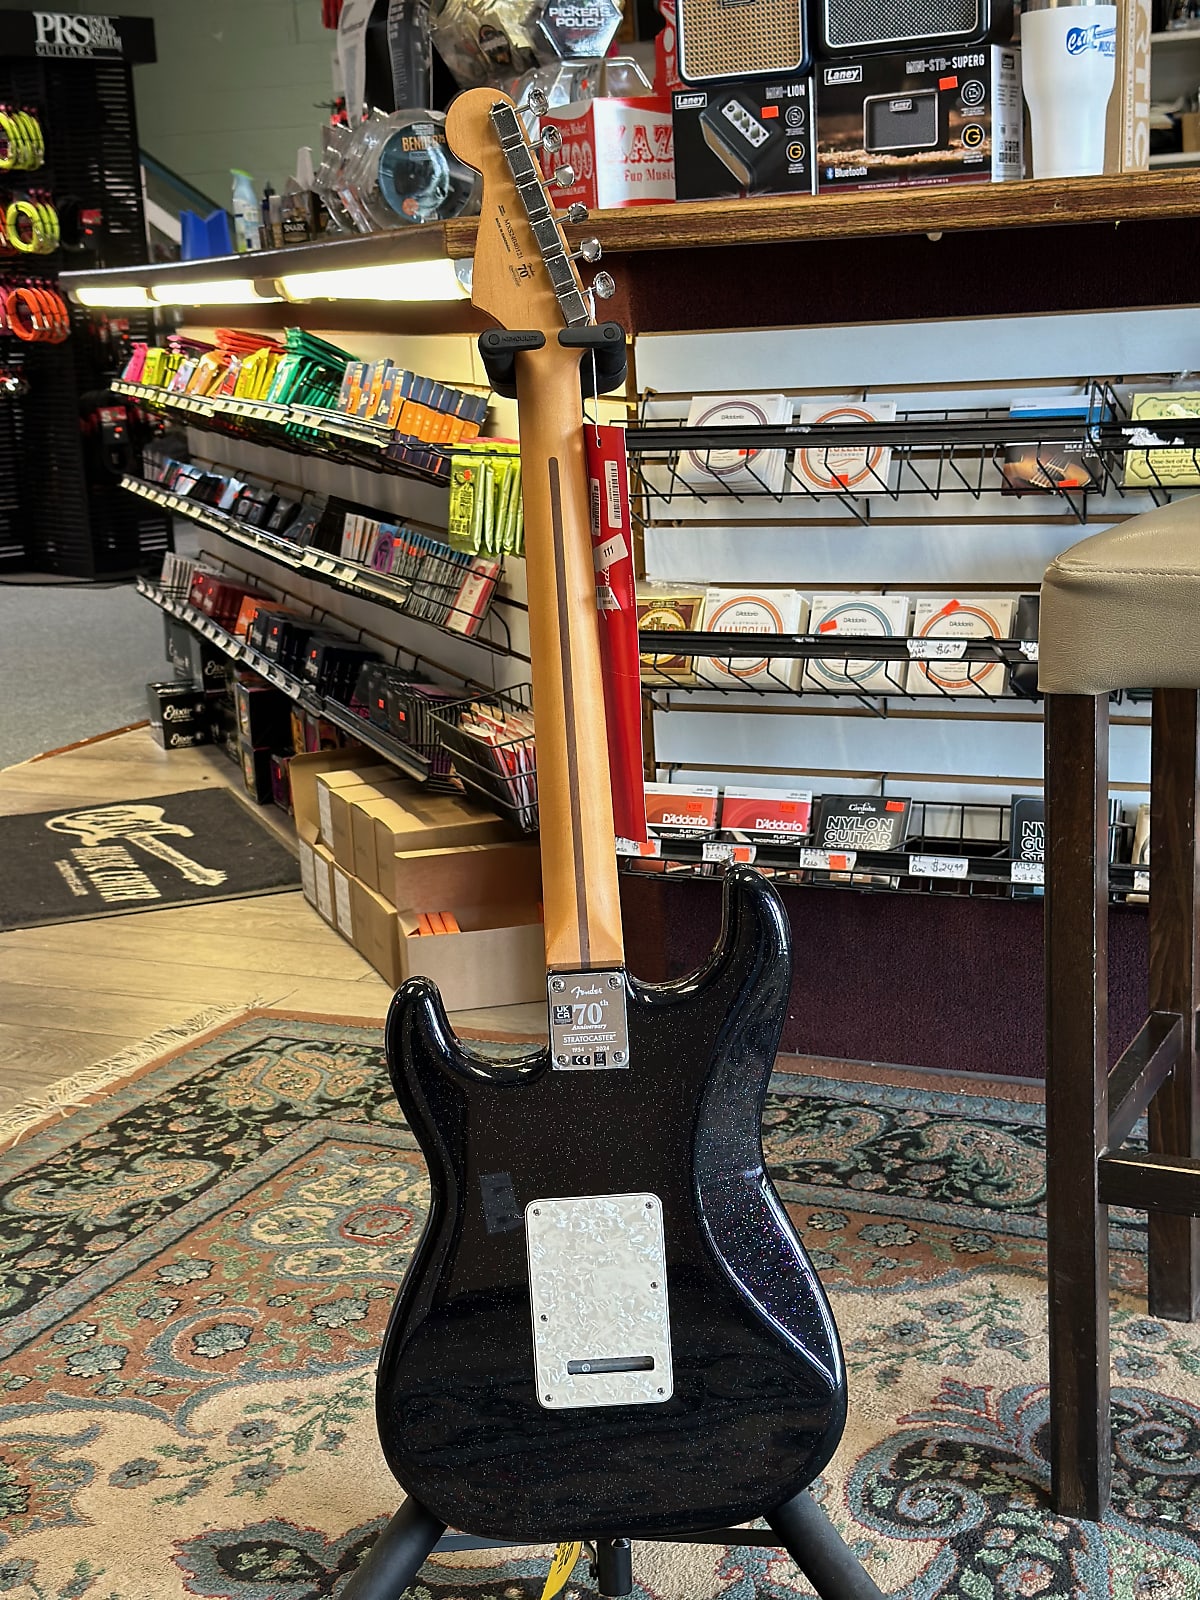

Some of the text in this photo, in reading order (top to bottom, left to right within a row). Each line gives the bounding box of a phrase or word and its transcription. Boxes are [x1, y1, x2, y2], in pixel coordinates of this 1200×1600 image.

[32, 11, 91, 46] PRS
[555, 17, 605, 27] POUCH
[827, 69, 860, 84] Laney
[677, 95, 705, 106] Laney
[624, 169, 643, 182] Fun
[834, 166, 868, 178] Bluetooth
[163, 704, 193, 721] Elixir
[662, 813, 708, 826] D'Addario
[755, 818, 803, 832] D'Addario
[826, 816, 894, 832] NYLON
[824, 829, 892, 844] GUITAR
[570, 984, 603, 999] Fender
[571, 1023, 607, 1031] Anniversary
[563, 1034, 616, 1044] STRATOCASTER
